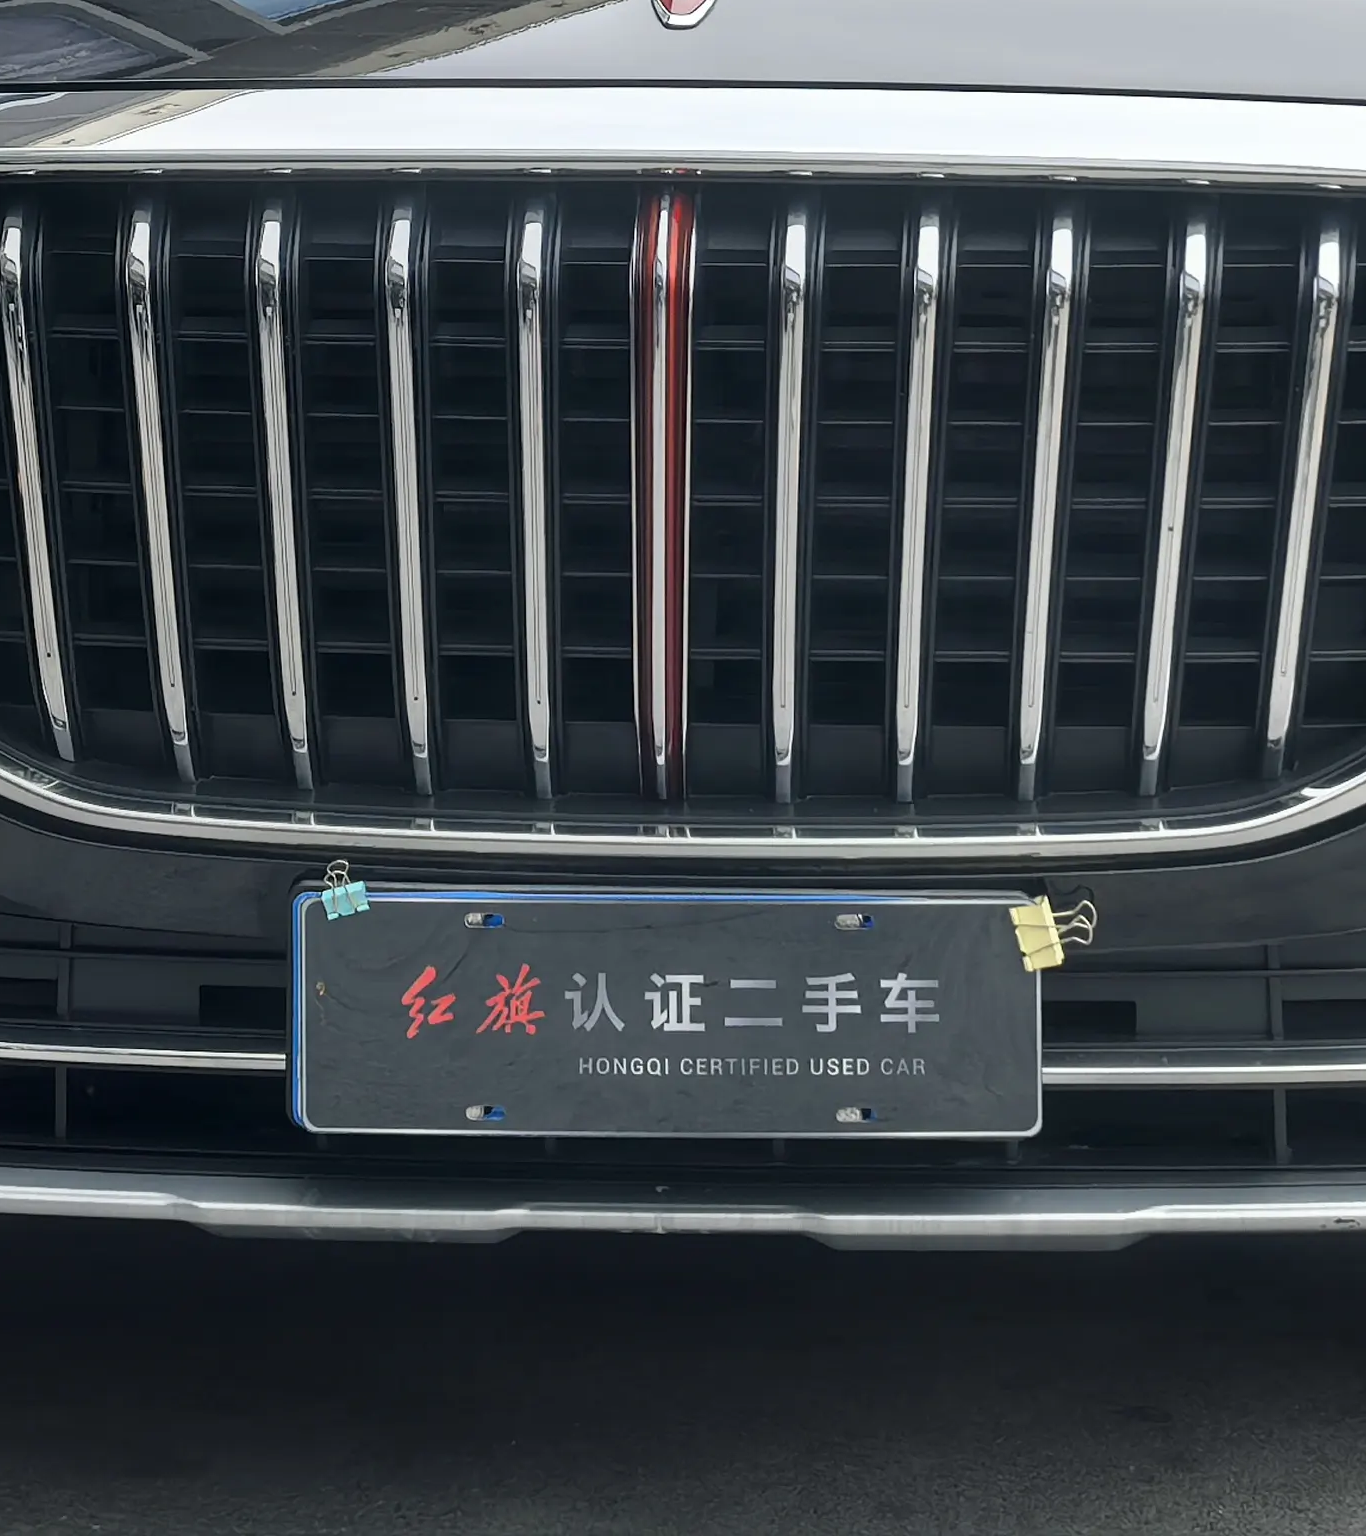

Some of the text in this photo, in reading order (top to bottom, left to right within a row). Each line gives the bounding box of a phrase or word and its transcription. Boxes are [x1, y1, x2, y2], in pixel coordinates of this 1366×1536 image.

[400, 963, 940, 1039] 红旗认证二手车
[578, 1056, 927, 1077] HONGQI CERTIFIED USED CAR
